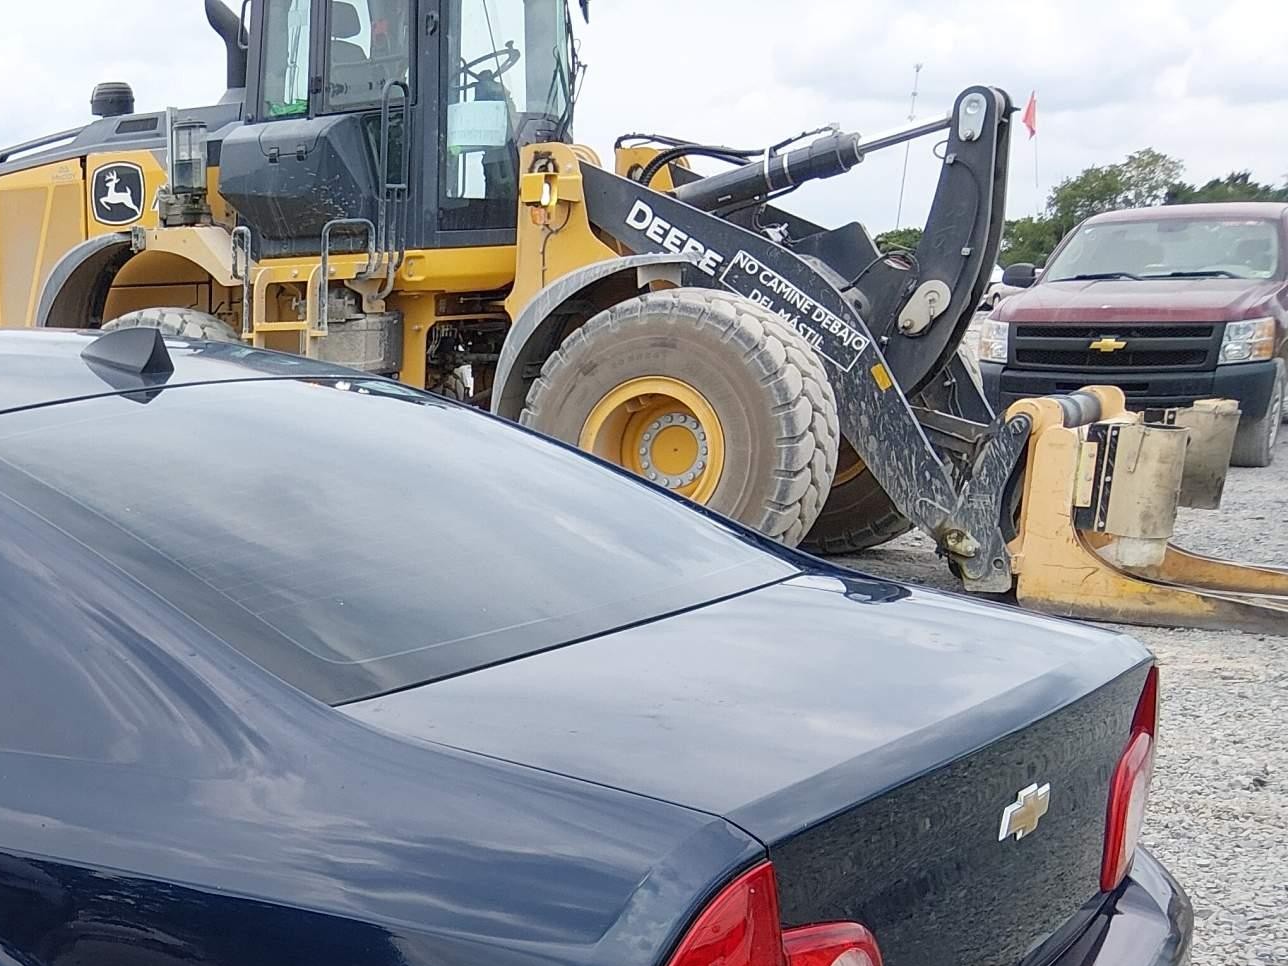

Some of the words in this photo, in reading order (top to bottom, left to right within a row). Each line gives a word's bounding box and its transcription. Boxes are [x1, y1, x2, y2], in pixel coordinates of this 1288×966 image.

[624, 199, 724, 277] DEERE
[734, 252, 759, 275] NO
[759, 270, 814, 314] CAMINE
[811, 307, 866, 350] DEBAJO
